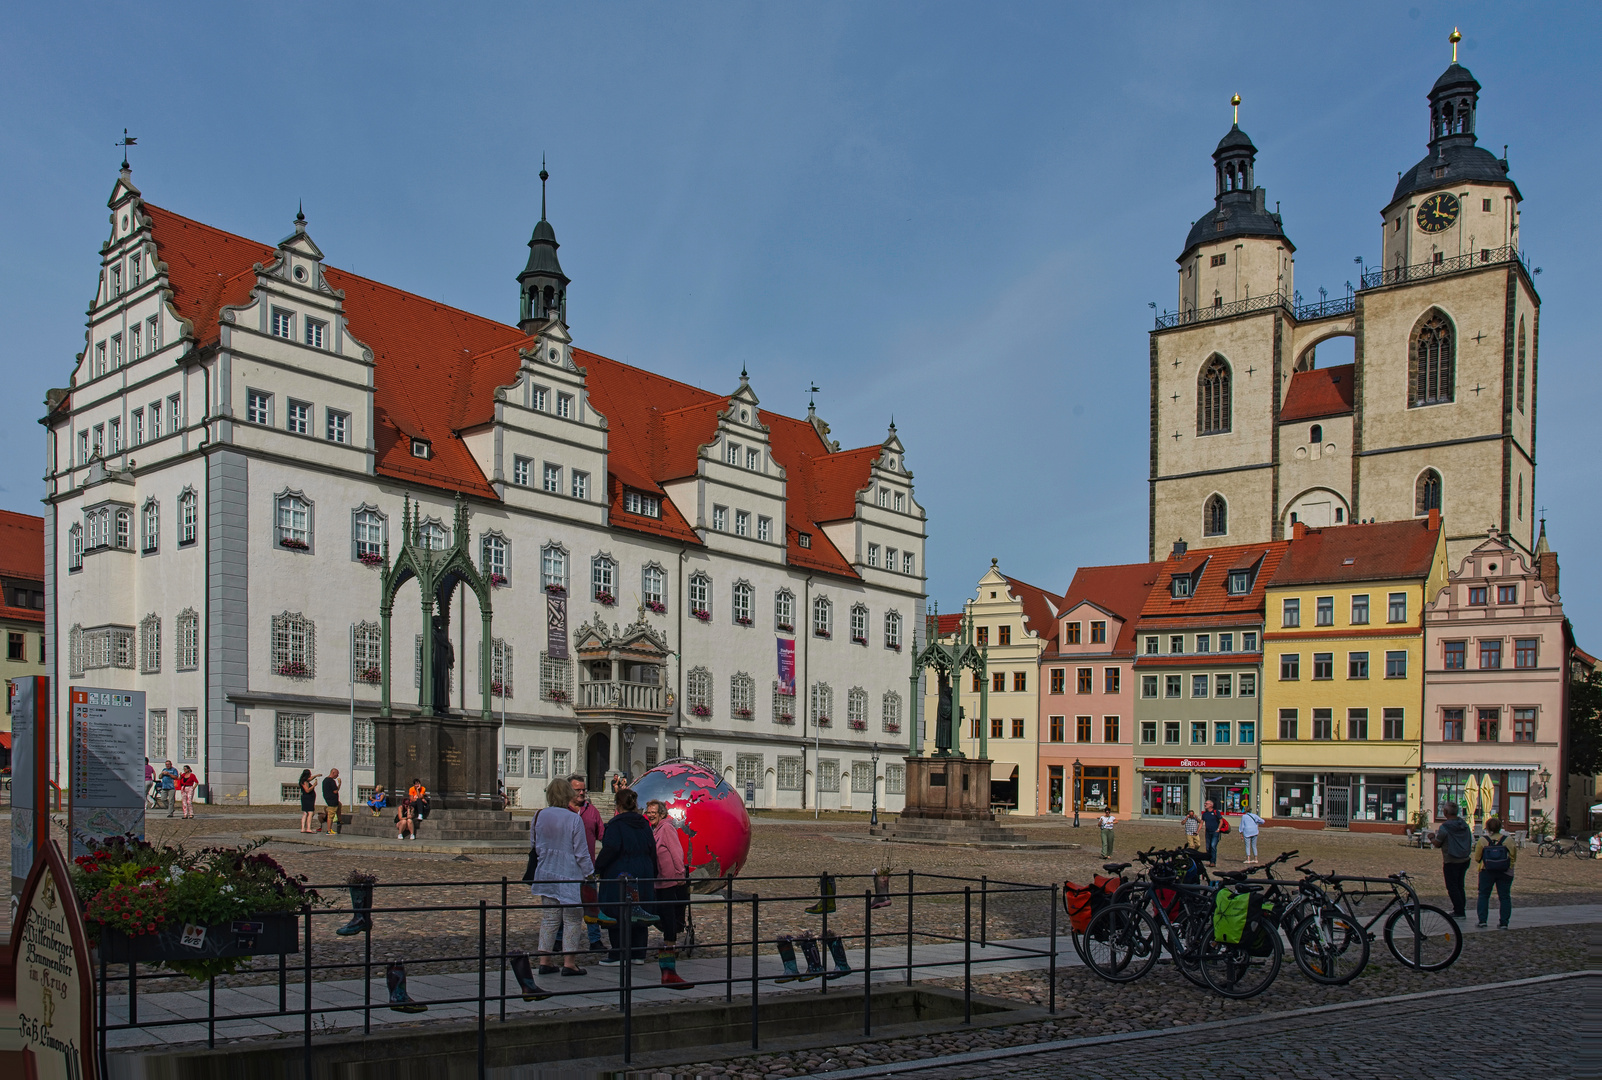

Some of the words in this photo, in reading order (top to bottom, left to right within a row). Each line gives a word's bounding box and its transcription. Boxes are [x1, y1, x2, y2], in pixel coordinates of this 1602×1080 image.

[25, 905, 65, 934] Original
[22, 921, 73, 960] Wittenberger
[183, 935, 202, 946] WB
[26, 943, 72, 977] Brunnenbier
[29, 965, 38, 981] im
[40, 968, 67, 999] Krug
[19, 1013, 39, 1045] Faß
